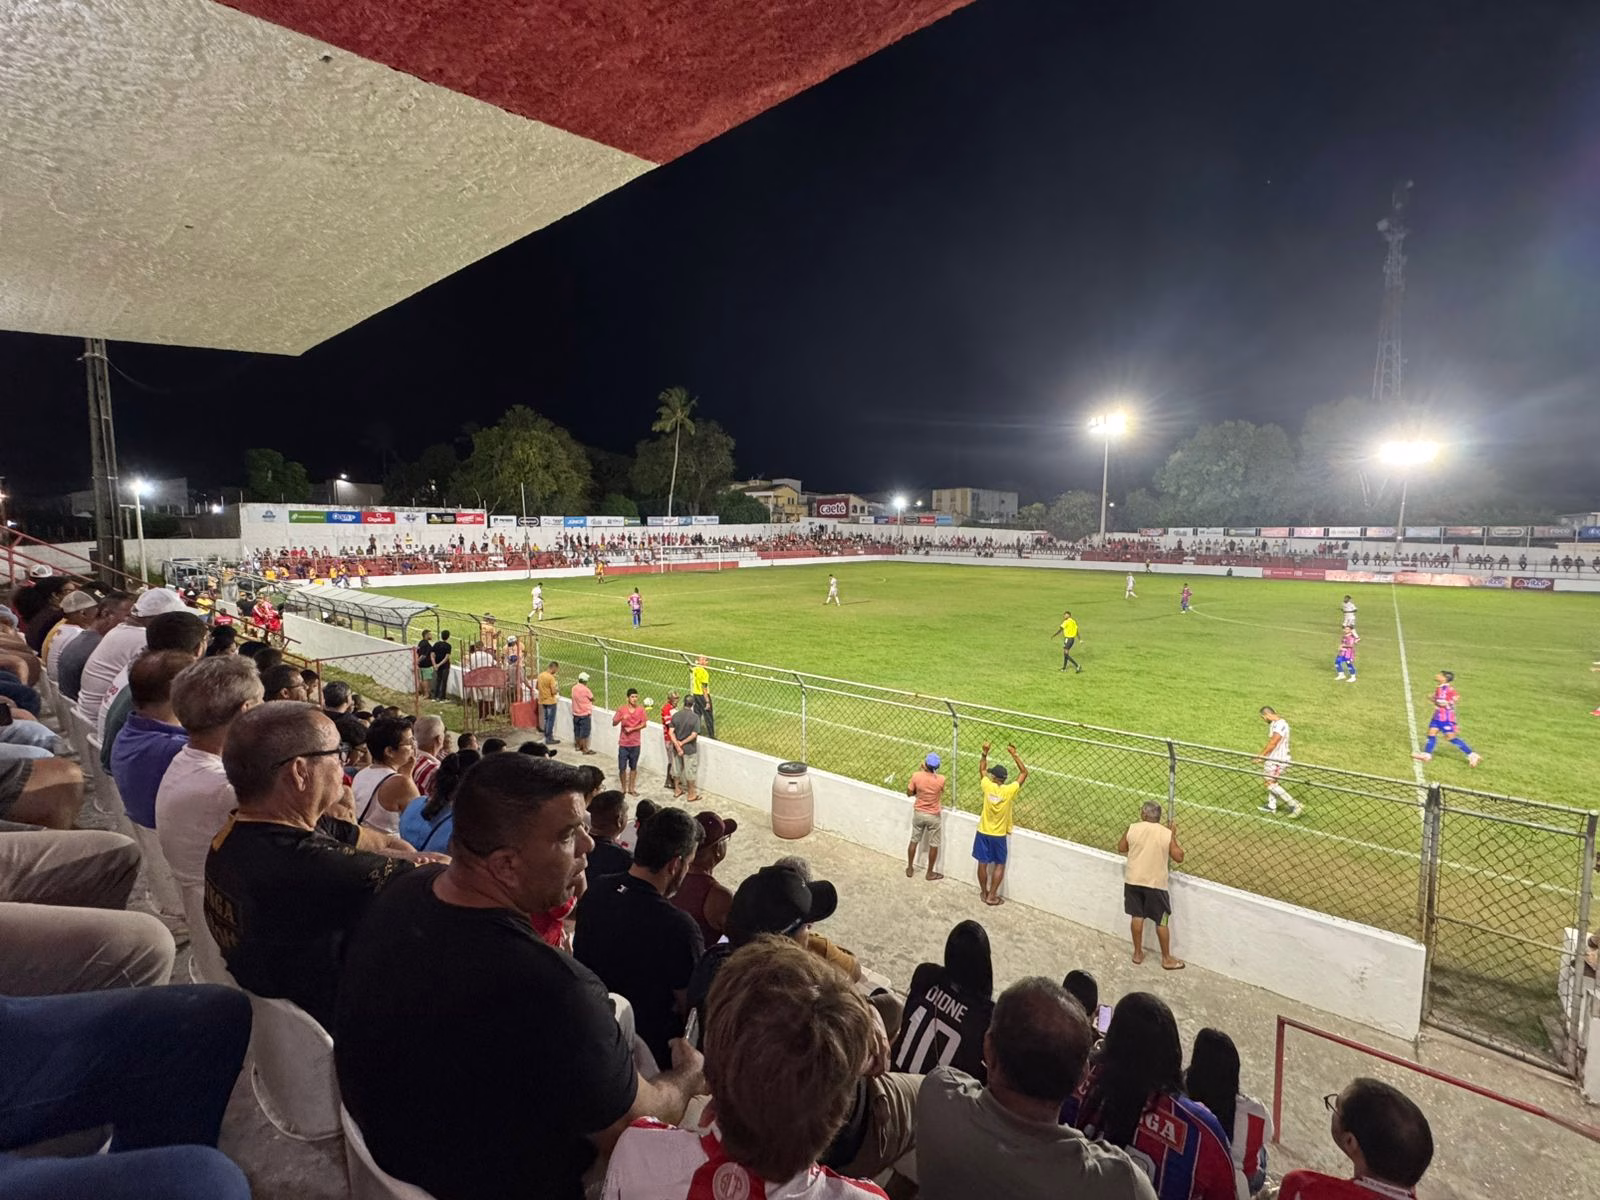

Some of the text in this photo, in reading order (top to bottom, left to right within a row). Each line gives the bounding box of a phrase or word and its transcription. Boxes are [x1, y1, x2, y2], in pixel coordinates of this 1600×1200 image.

[925, 985, 968, 1023] DIONE
[896, 1005, 962, 1075] 10
[1139, 1111, 1177, 1144] GA
